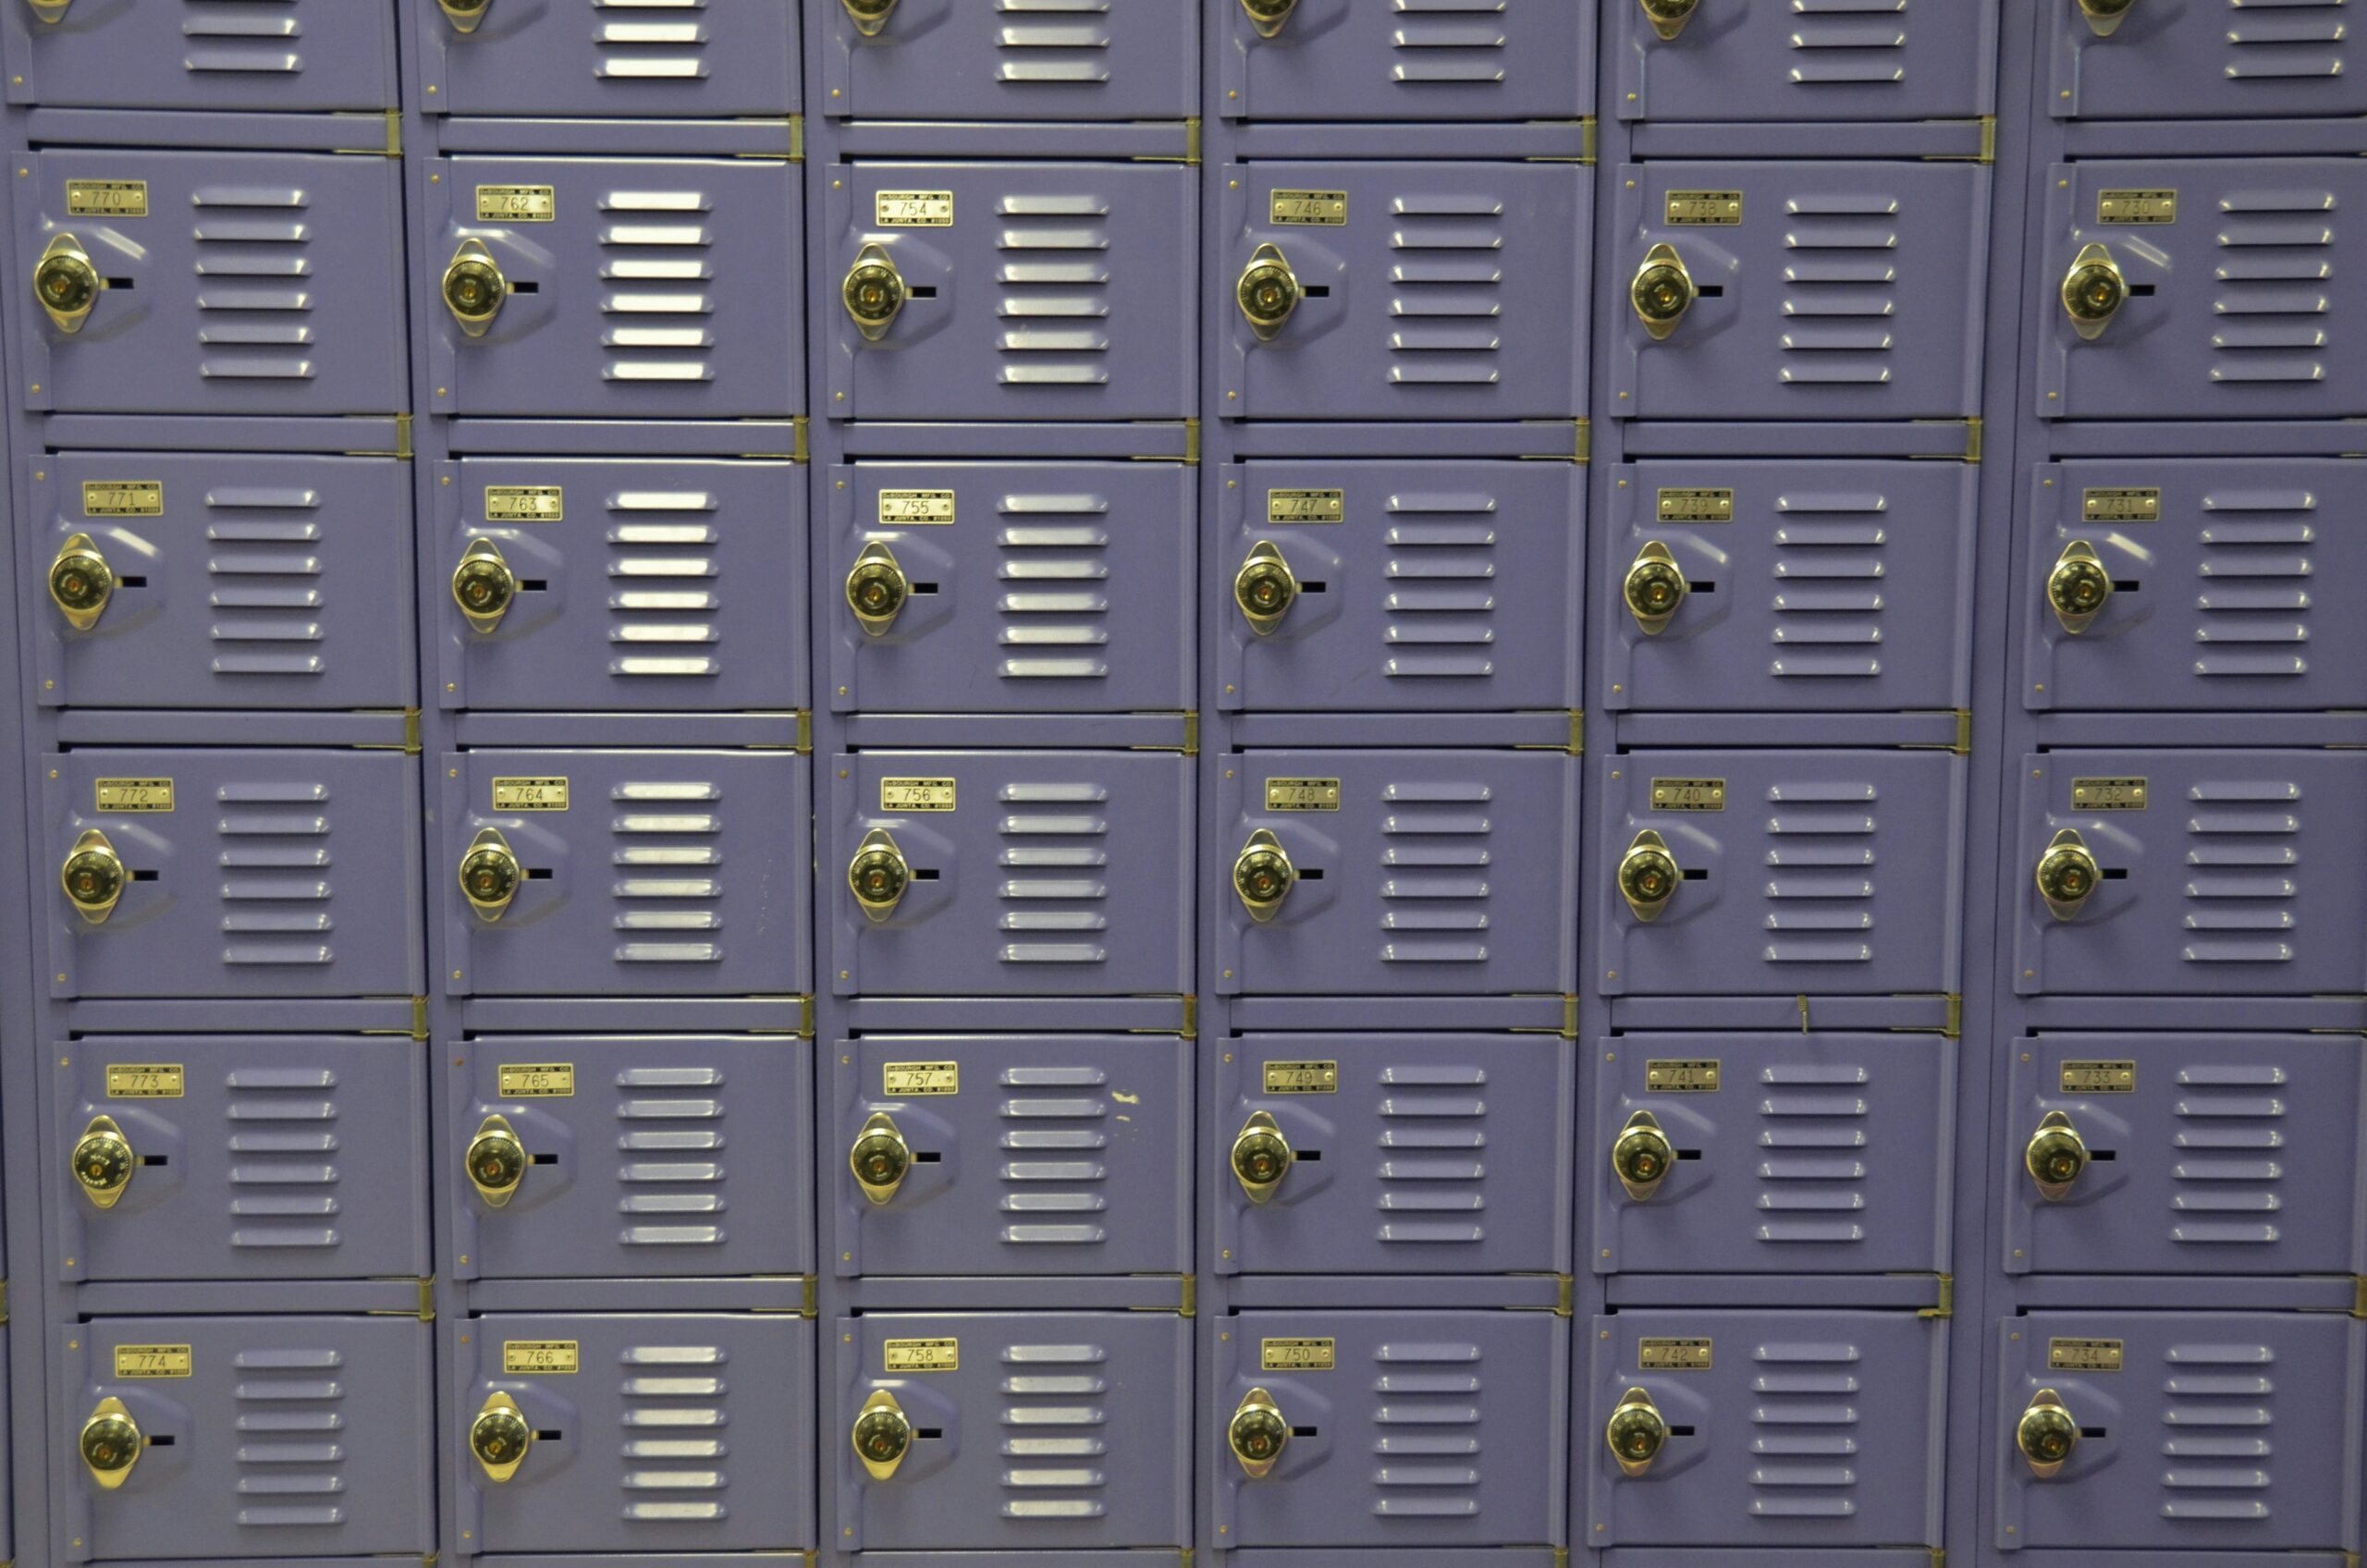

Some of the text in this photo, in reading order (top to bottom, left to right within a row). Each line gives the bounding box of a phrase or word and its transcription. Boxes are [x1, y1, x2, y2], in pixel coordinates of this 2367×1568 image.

[92, 190, 120, 206] 770
[500, 196, 528, 211] 762
[900, 202, 926, 215] 754
[1294, 200, 1320, 215] 746
[1688, 201, 1716, 215] 738
[2121, 200, 2149, 214] 730
[107, 491, 136, 506] 771
[509, 496, 536, 510] 763
[1680, 498, 1707, 512] 739
[2106, 497, 2133, 512] 731
[902, 499, 928, 514] 755
[1291, 499, 1318, 513] 747
[119, 788, 147, 802] 772
[516, 787, 543, 801] 764
[904, 788, 930, 802] 756
[1288, 788, 1315, 802] 748
[1674, 788, 1699, 802] 740
[2094, 787, 2121, 801] 732
[130, 1074, 157, 1087] 773
[521, 1073, 548, 1087] 765
[906, 1072, 933, 1085] 757
[1286, 1071, 1312, 1084] 749
[1668, 1069, 1694, 1083] 741
[2083, 1070, 2109, 1084] 733
[527, 1350, 553, 1364] 766
[907, 1348, 933, 1362] 758
[1284, 1347, 1309, 1361] 750
[1662, 1347, 1686, 1360] 742
[2071, 1348, 2097, 1362] 734
[139, 1354, 166, 1368] 774
